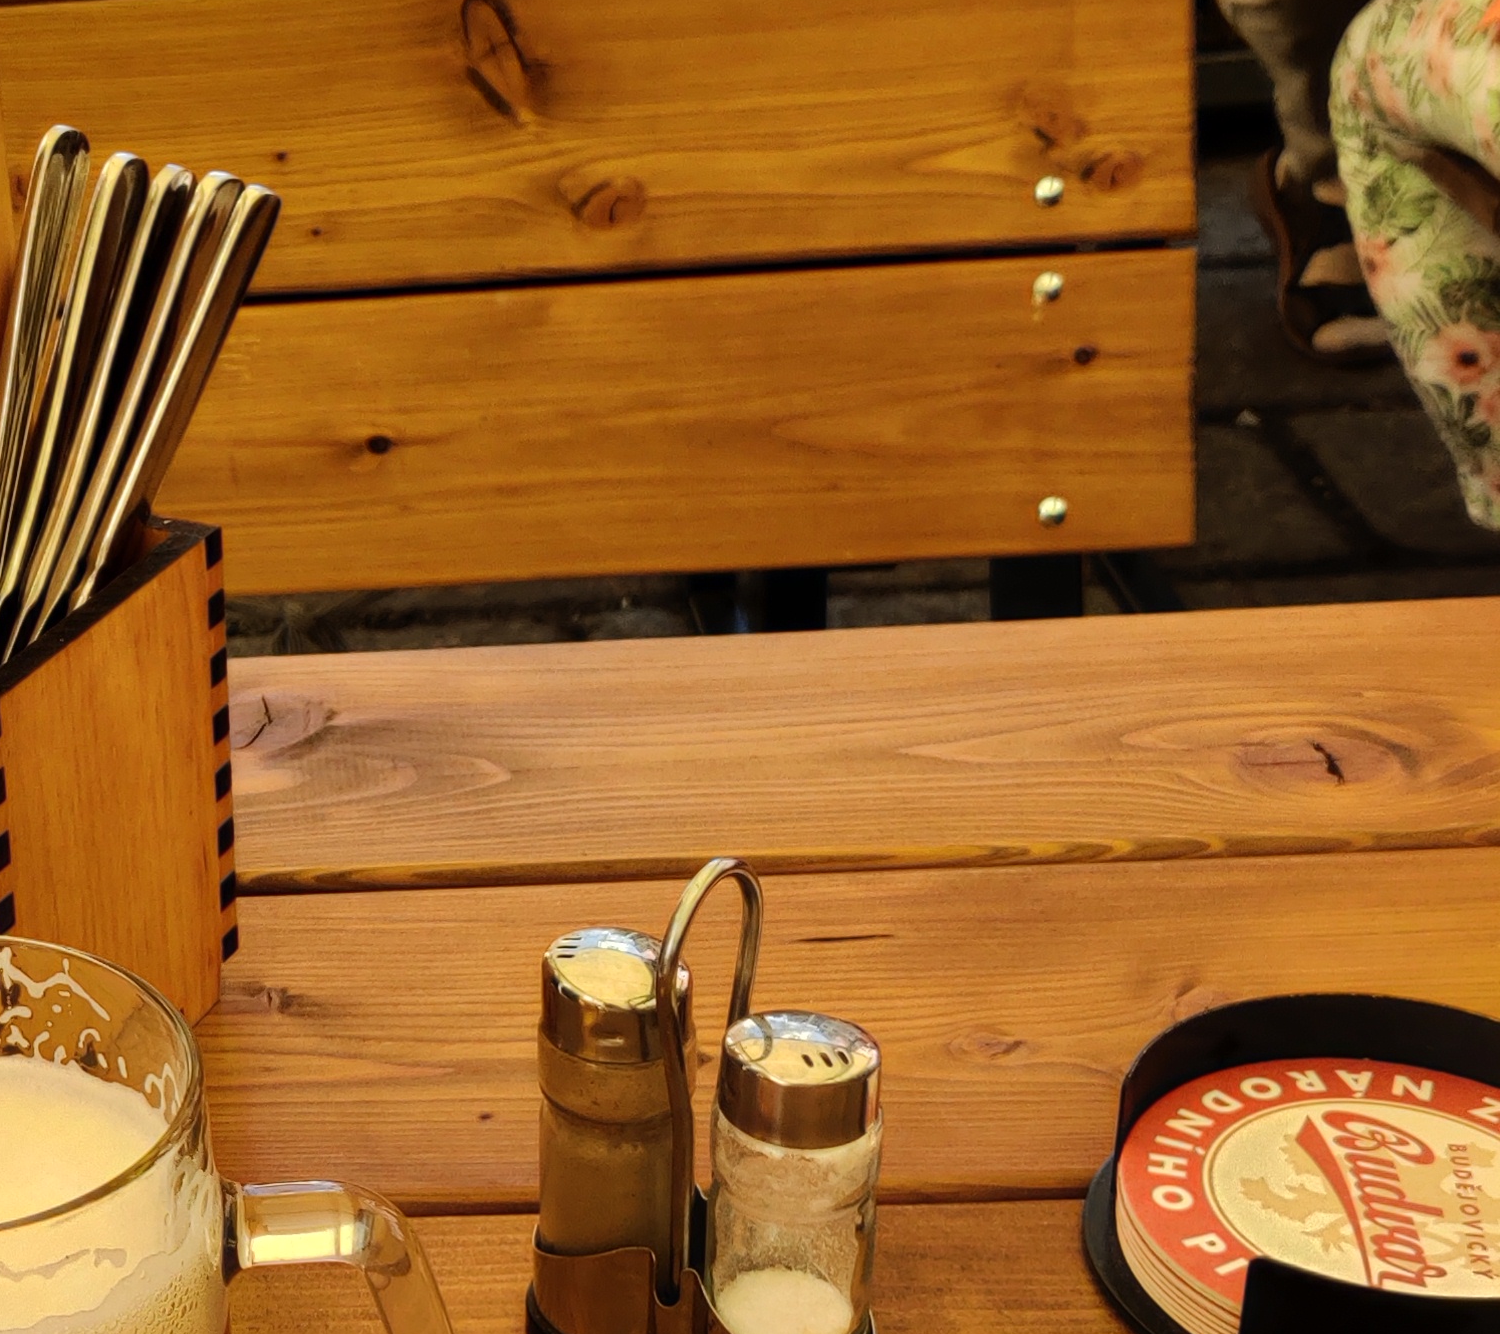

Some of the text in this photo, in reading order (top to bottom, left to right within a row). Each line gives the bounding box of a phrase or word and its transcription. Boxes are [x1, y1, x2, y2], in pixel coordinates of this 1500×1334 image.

[1147, 1070, 1434, 1211] NÁRODNÍHO
[1320, 1110, 1448, 1289] Budvar
[1181, 1232, 1249, 1276] PI
